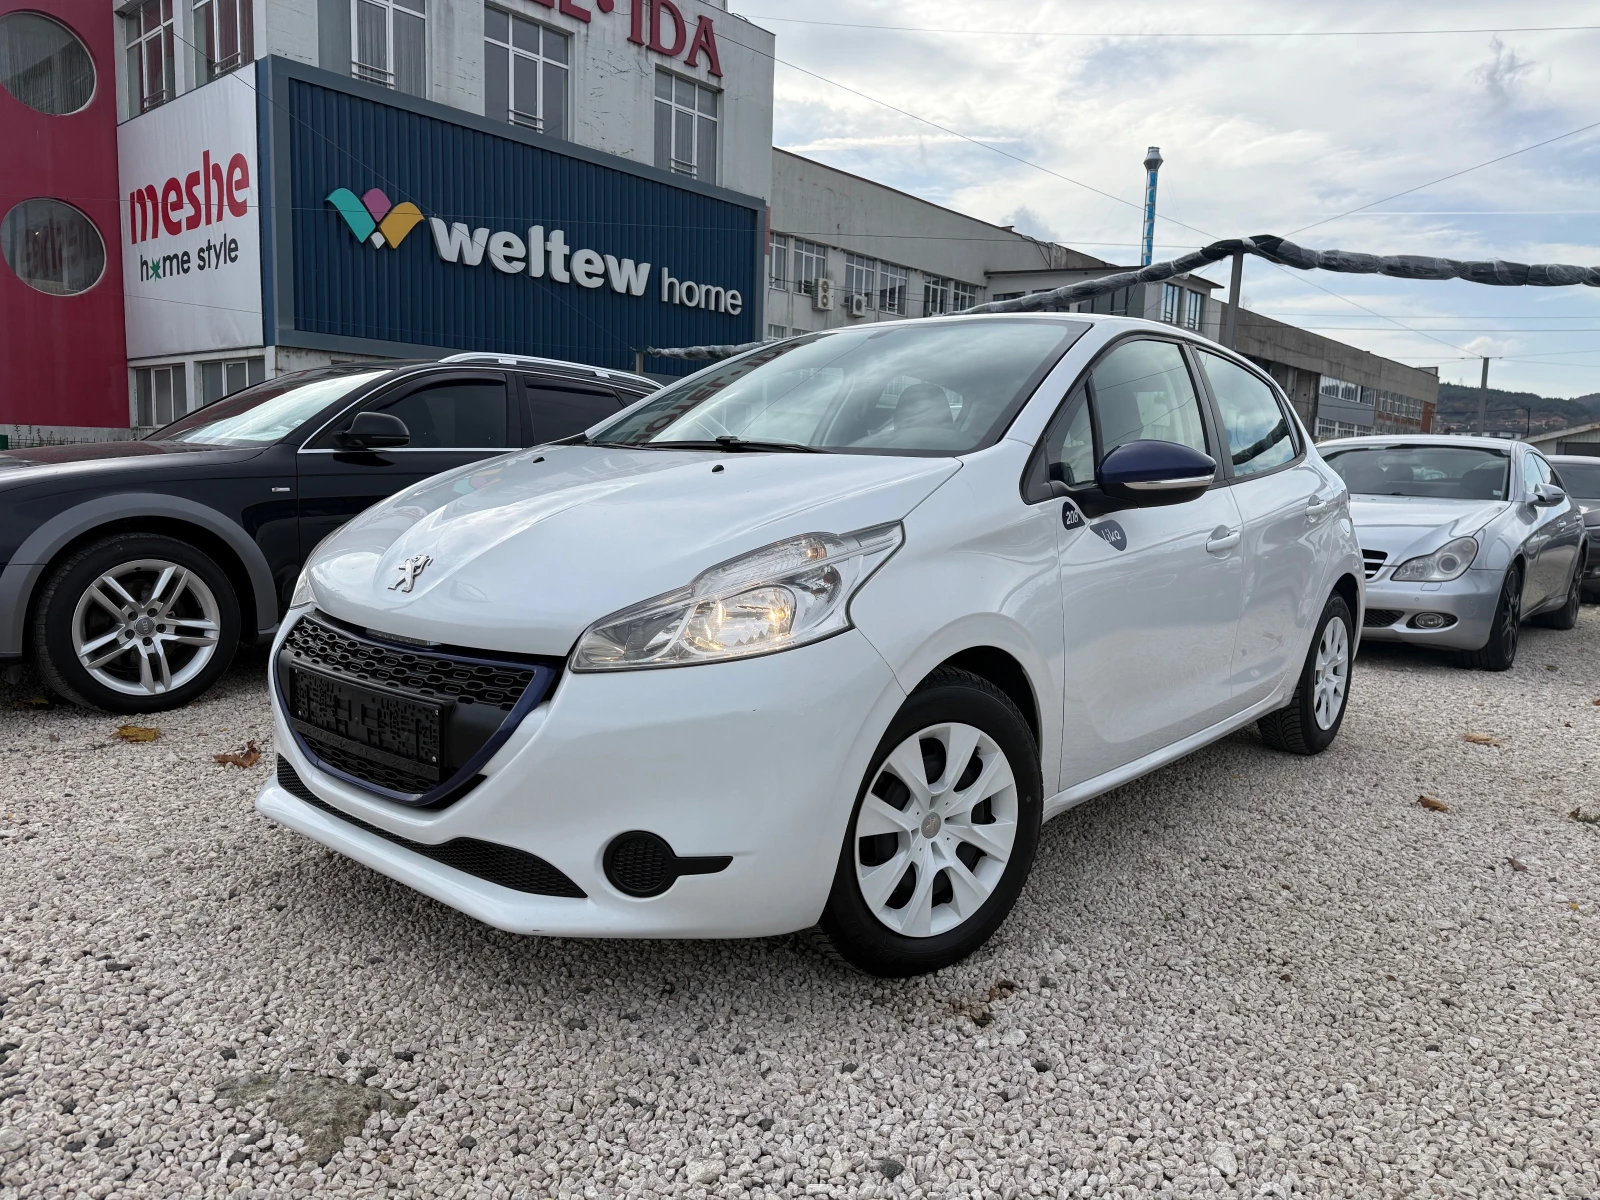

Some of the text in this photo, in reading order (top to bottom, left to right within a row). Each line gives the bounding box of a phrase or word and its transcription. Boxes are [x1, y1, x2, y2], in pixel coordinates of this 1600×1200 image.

[627, 0, 723, 77] IDA
[130, 149, 249, 245] meshe
[140, 233, 239, 282] hme style
[428, 217, 742, 315] weltew home
